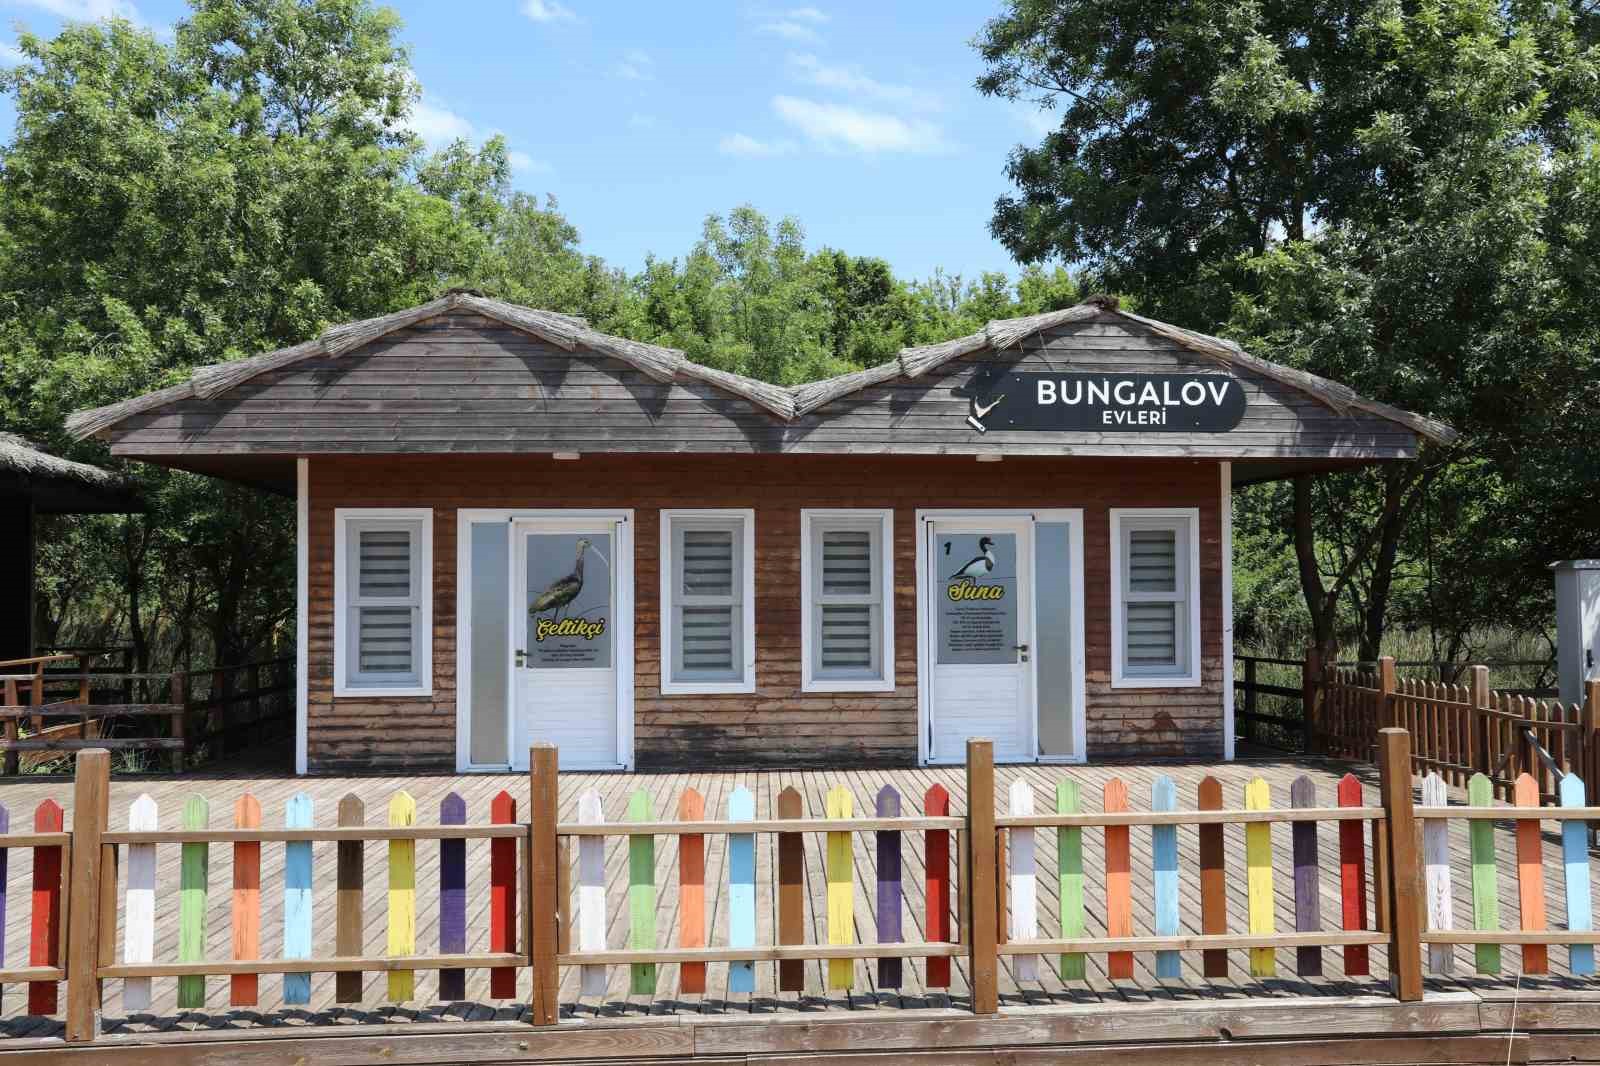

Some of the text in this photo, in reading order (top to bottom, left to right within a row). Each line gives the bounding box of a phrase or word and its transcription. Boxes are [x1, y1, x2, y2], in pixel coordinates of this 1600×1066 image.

[1037, 380, 1229, 406] BUNGALOV
[1102, 407, 1167, 425] EVLERİ
[944, 541, 952, 556] 1
[948, 580, 1005, 601] Suna
[536, 617, 605, 641] Çeltikçi
